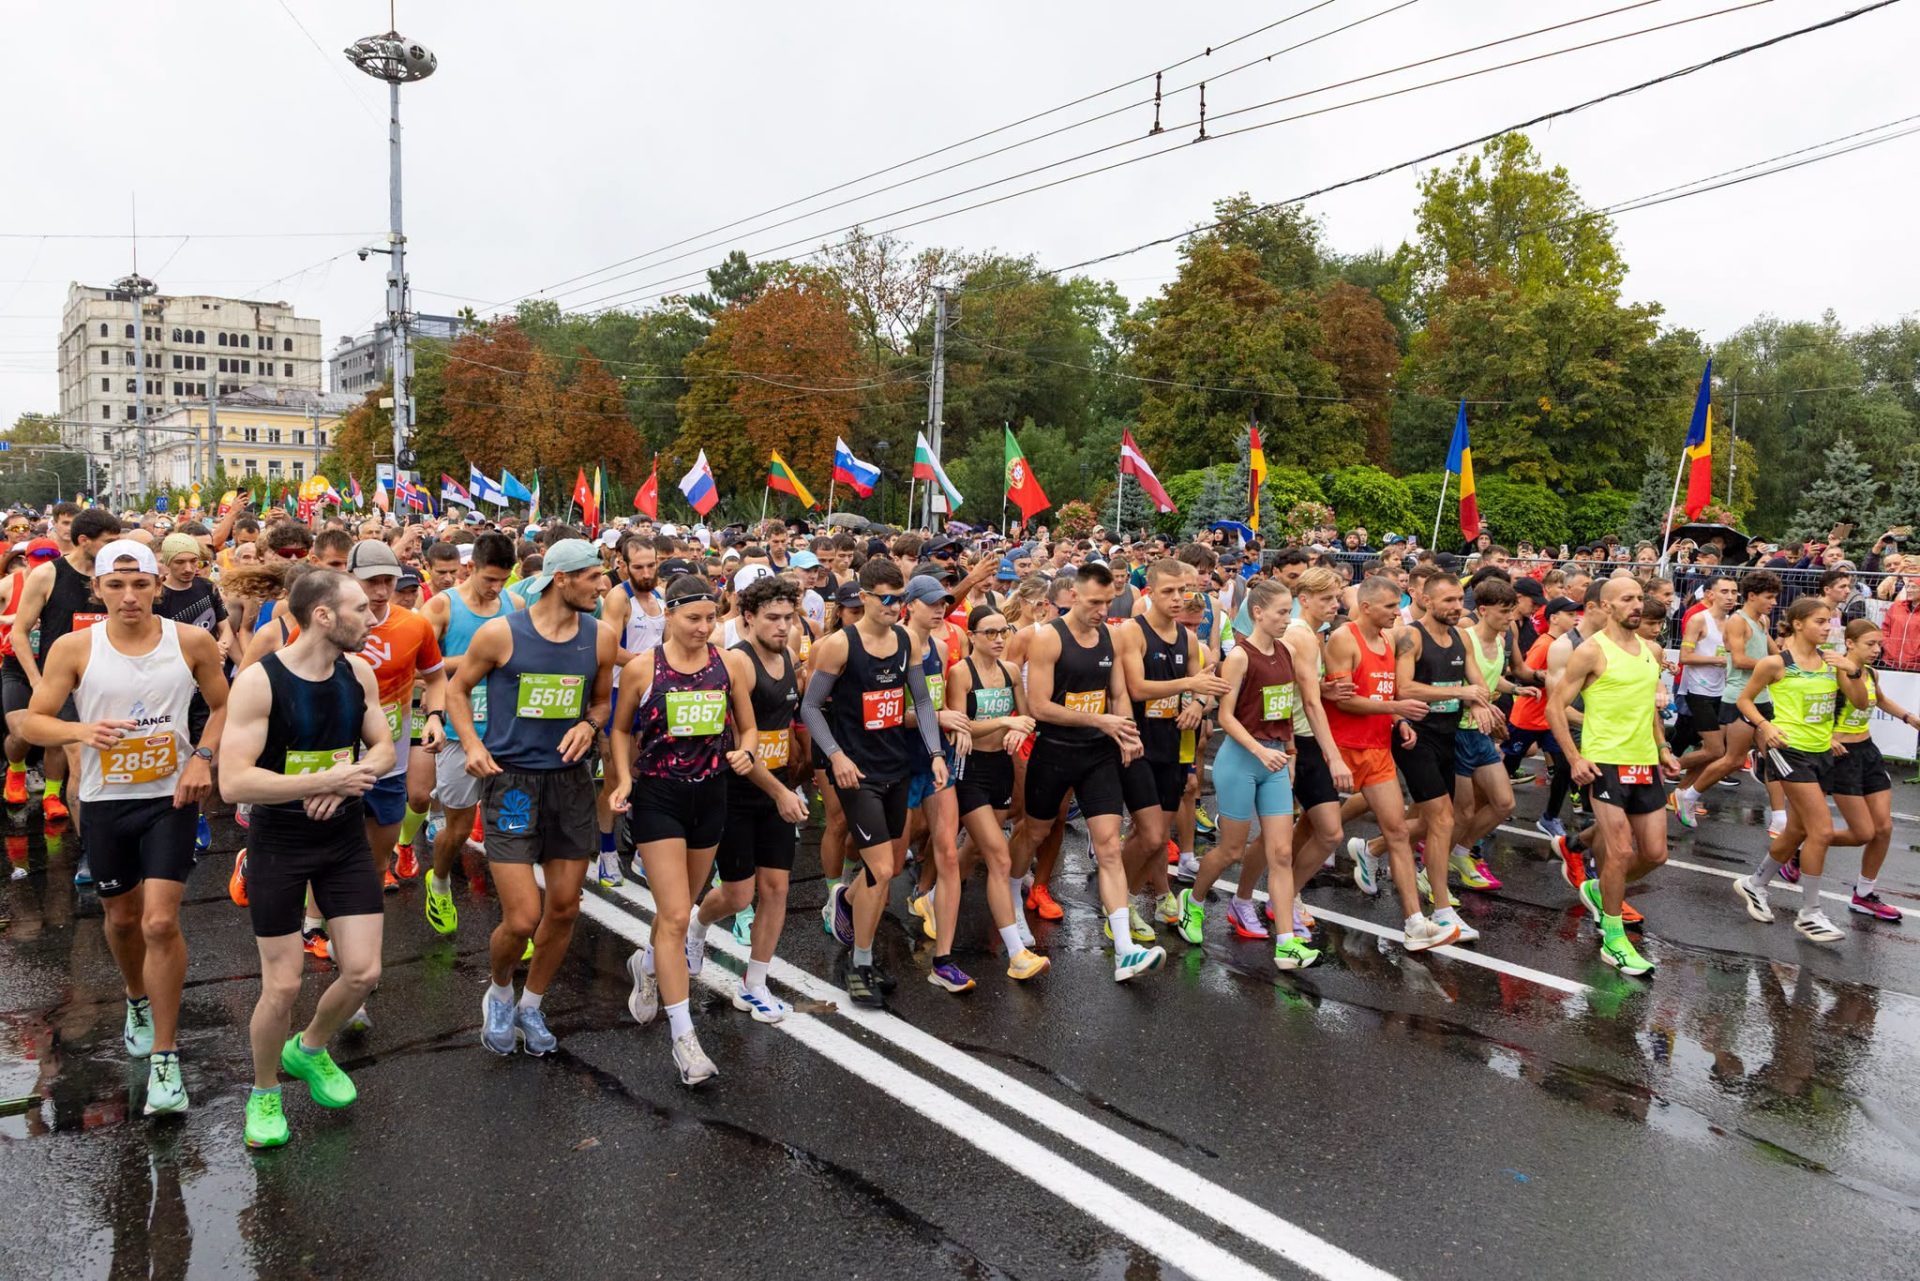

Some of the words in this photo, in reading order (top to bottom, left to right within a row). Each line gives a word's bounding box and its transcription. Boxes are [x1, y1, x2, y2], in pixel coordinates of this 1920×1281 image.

[1376, 681, 1394, 694] 489
[529, 688, 576, 706] 5518
[983, 698, 1010, 713] 1496
[676, 704, 722, 723] 5857
[881, 700, 904, 718] 361
[135, 715, 172, 726] RANCE
[110, 748, 170, 772] 2852
